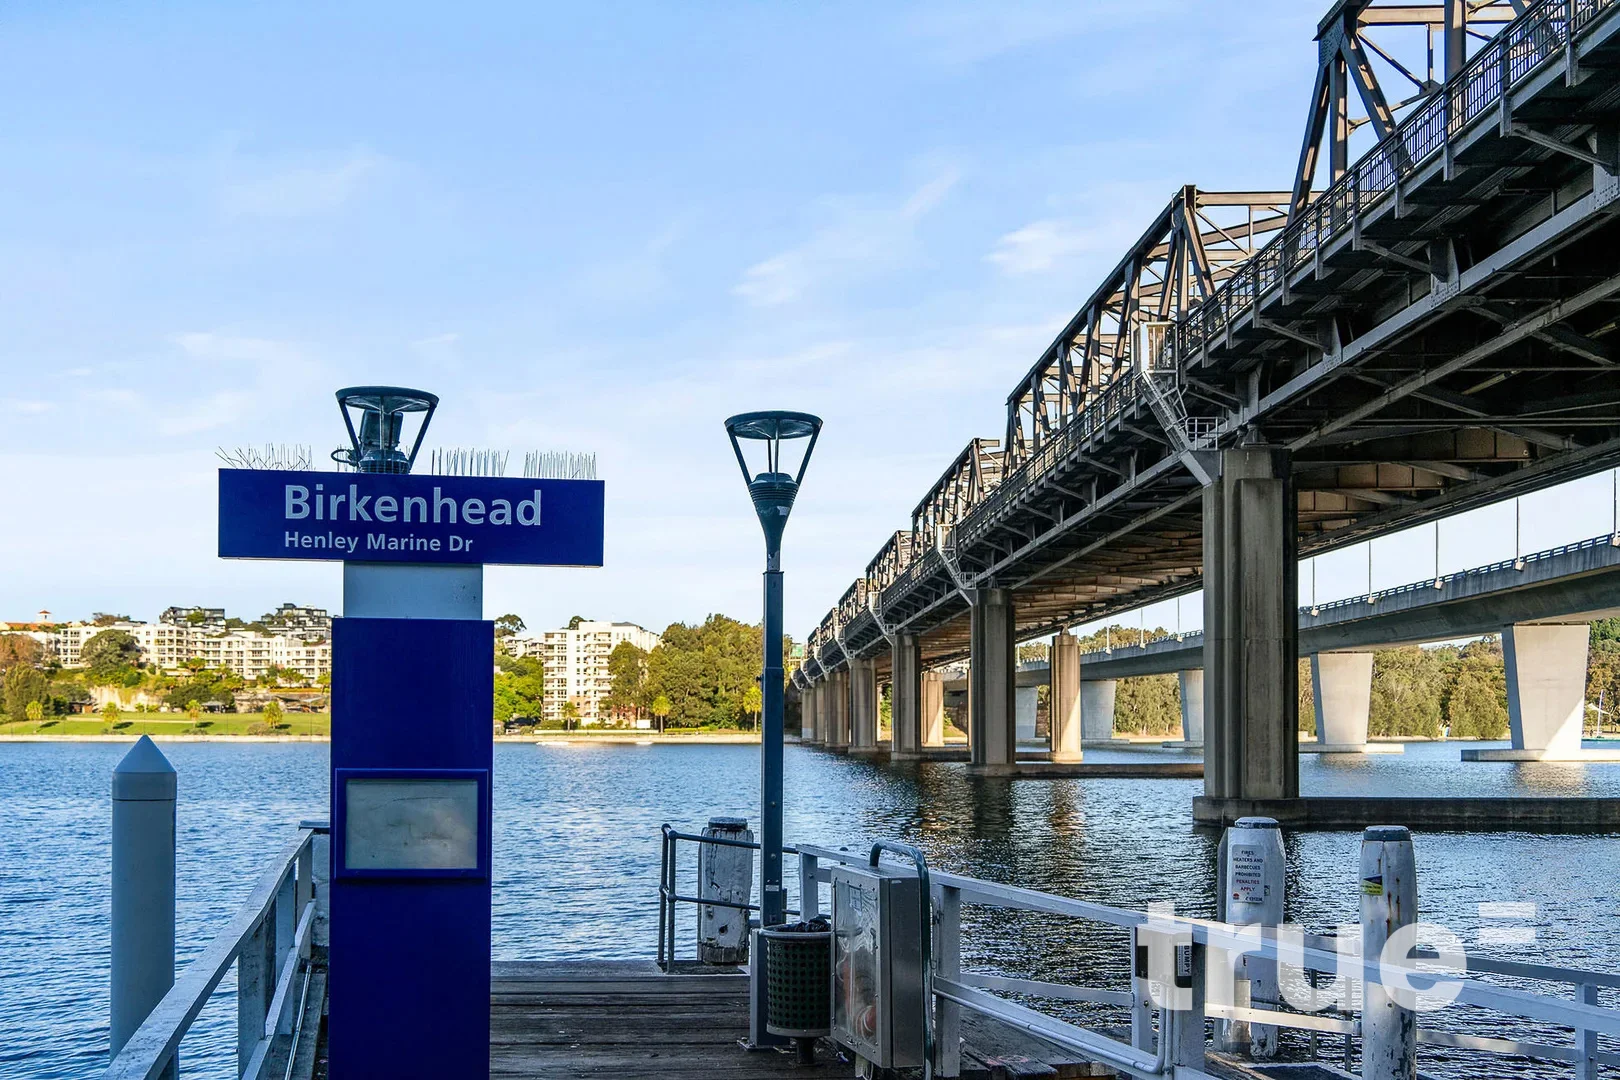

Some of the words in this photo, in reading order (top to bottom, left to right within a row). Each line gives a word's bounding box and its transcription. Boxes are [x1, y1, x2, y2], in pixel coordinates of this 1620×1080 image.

[284, 484, 542, 527] Birkenhead
[284, 531, 359, 553] Henley
[367, 533, 441, 552] Marine
[449, 535, 474, 552] Dr
